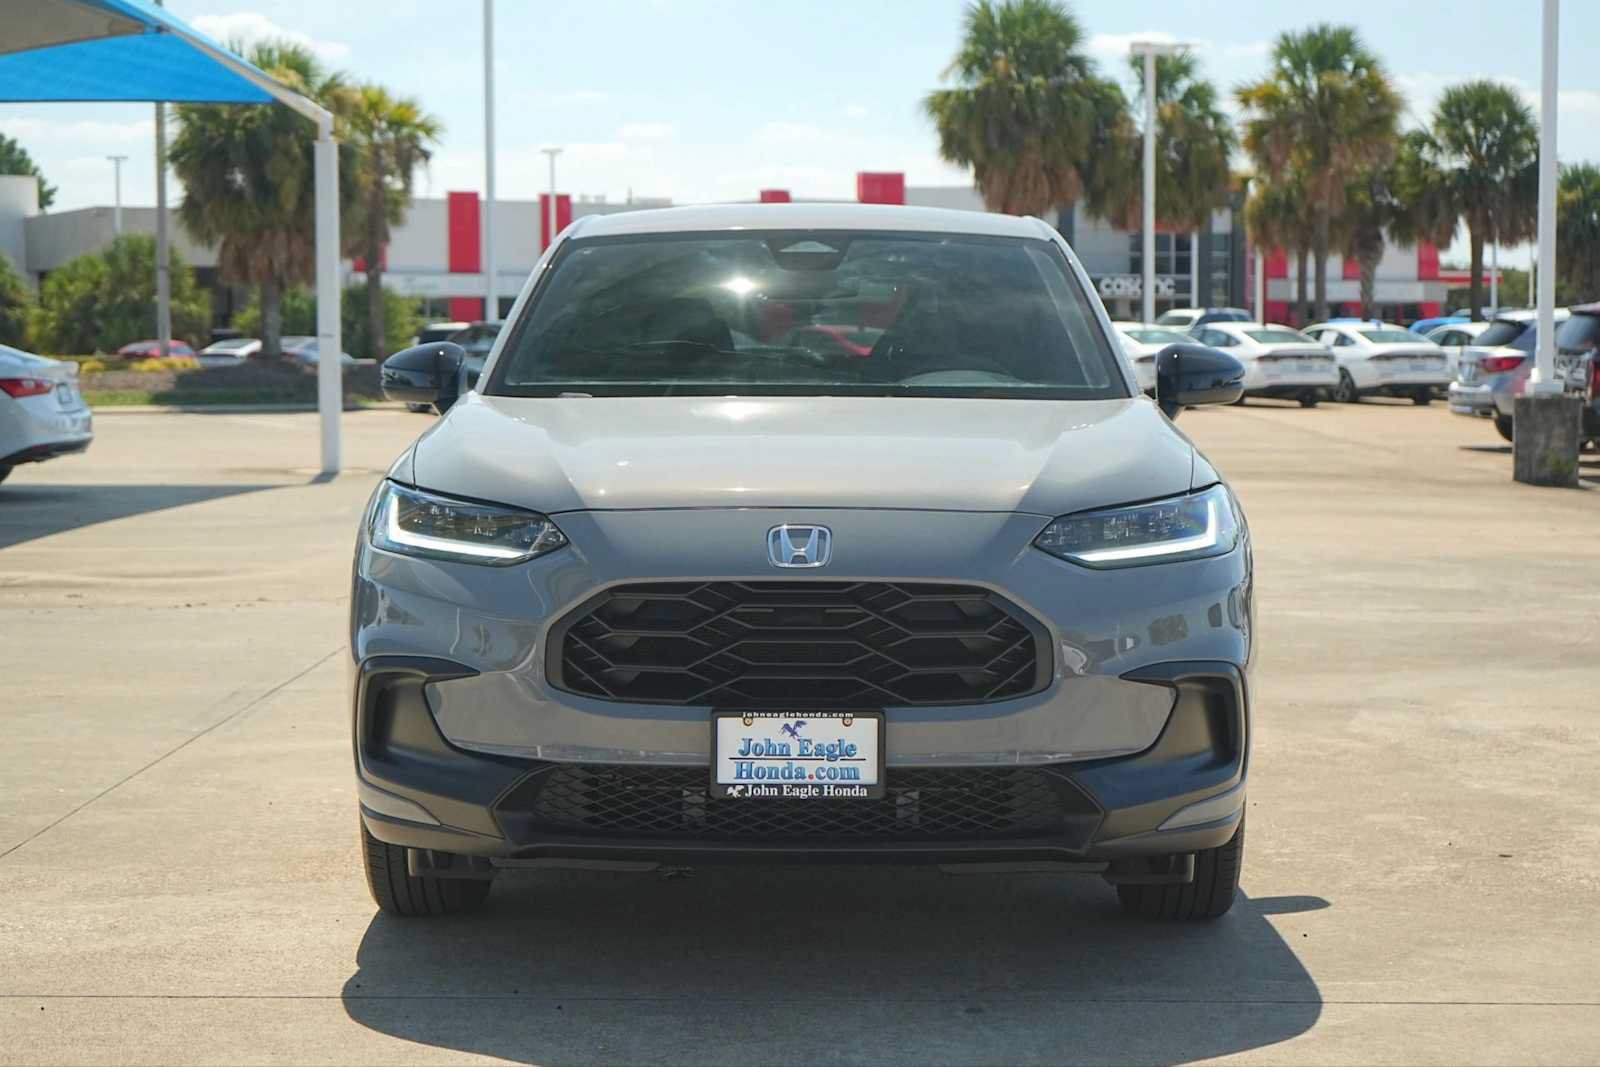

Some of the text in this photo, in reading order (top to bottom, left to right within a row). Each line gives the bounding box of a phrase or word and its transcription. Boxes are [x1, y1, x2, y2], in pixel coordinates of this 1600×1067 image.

[738, 737, 857, 762] John Eagle
[734, 761, 860, 780] Honda.com
[745, 784, 868, 799] John Eagle Honda
